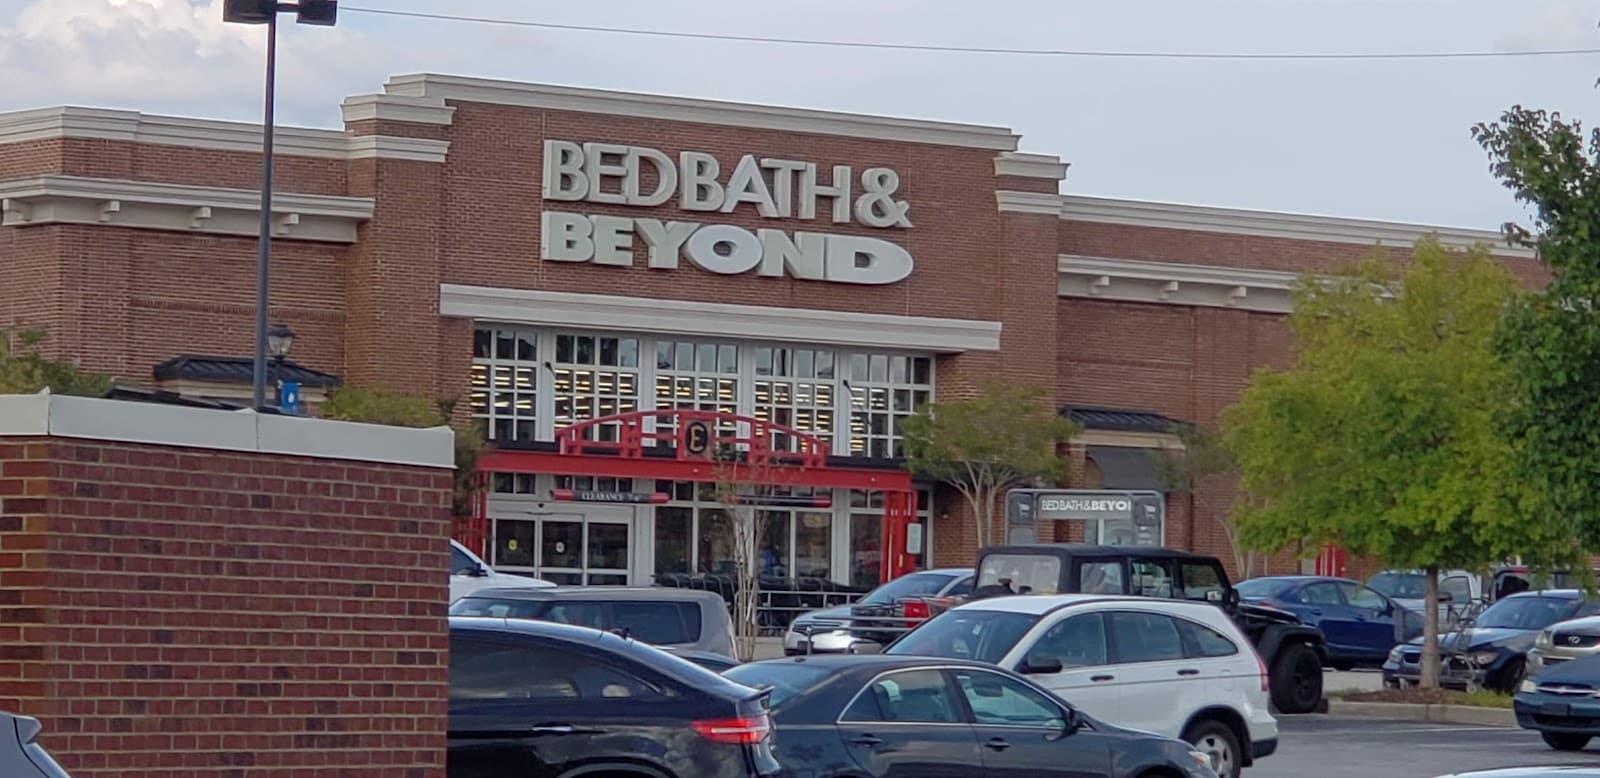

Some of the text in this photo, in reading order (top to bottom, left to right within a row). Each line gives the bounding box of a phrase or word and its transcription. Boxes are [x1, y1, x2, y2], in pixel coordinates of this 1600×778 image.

[543, 140, 913, 228] BED BATH &
[541, 210, 914, 284] BEYOND
[1091, 500, 1131, 511] BEYO
